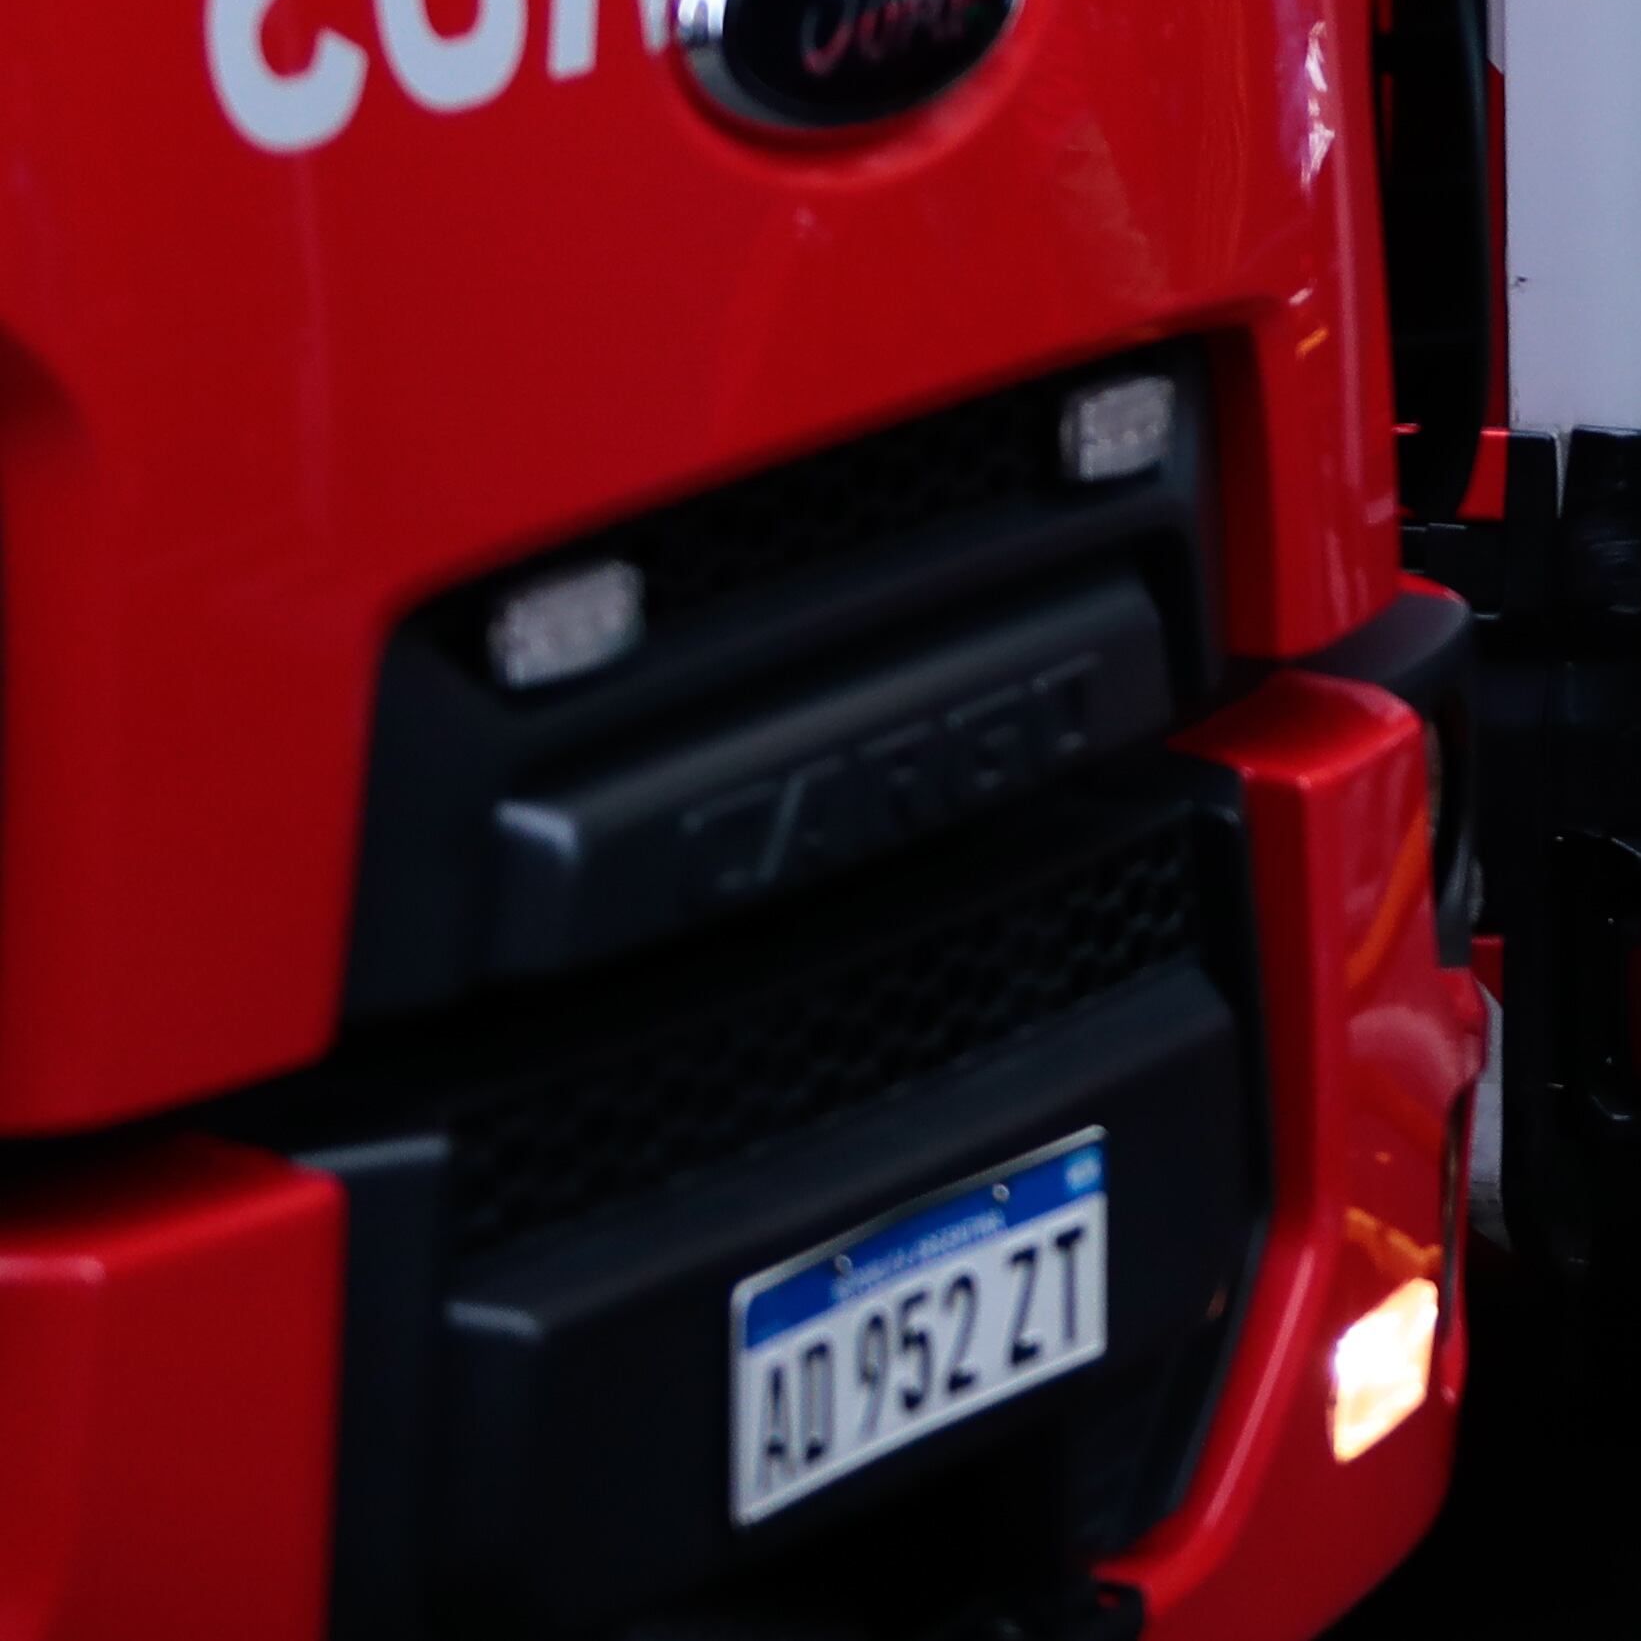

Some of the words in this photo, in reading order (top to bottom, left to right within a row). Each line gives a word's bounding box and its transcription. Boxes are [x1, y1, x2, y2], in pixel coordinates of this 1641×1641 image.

[756, 1343, 833, 1489] AD
[860, 1275, 978, 1437] 952
[1010, 1227, 1082, 1366] ZT
